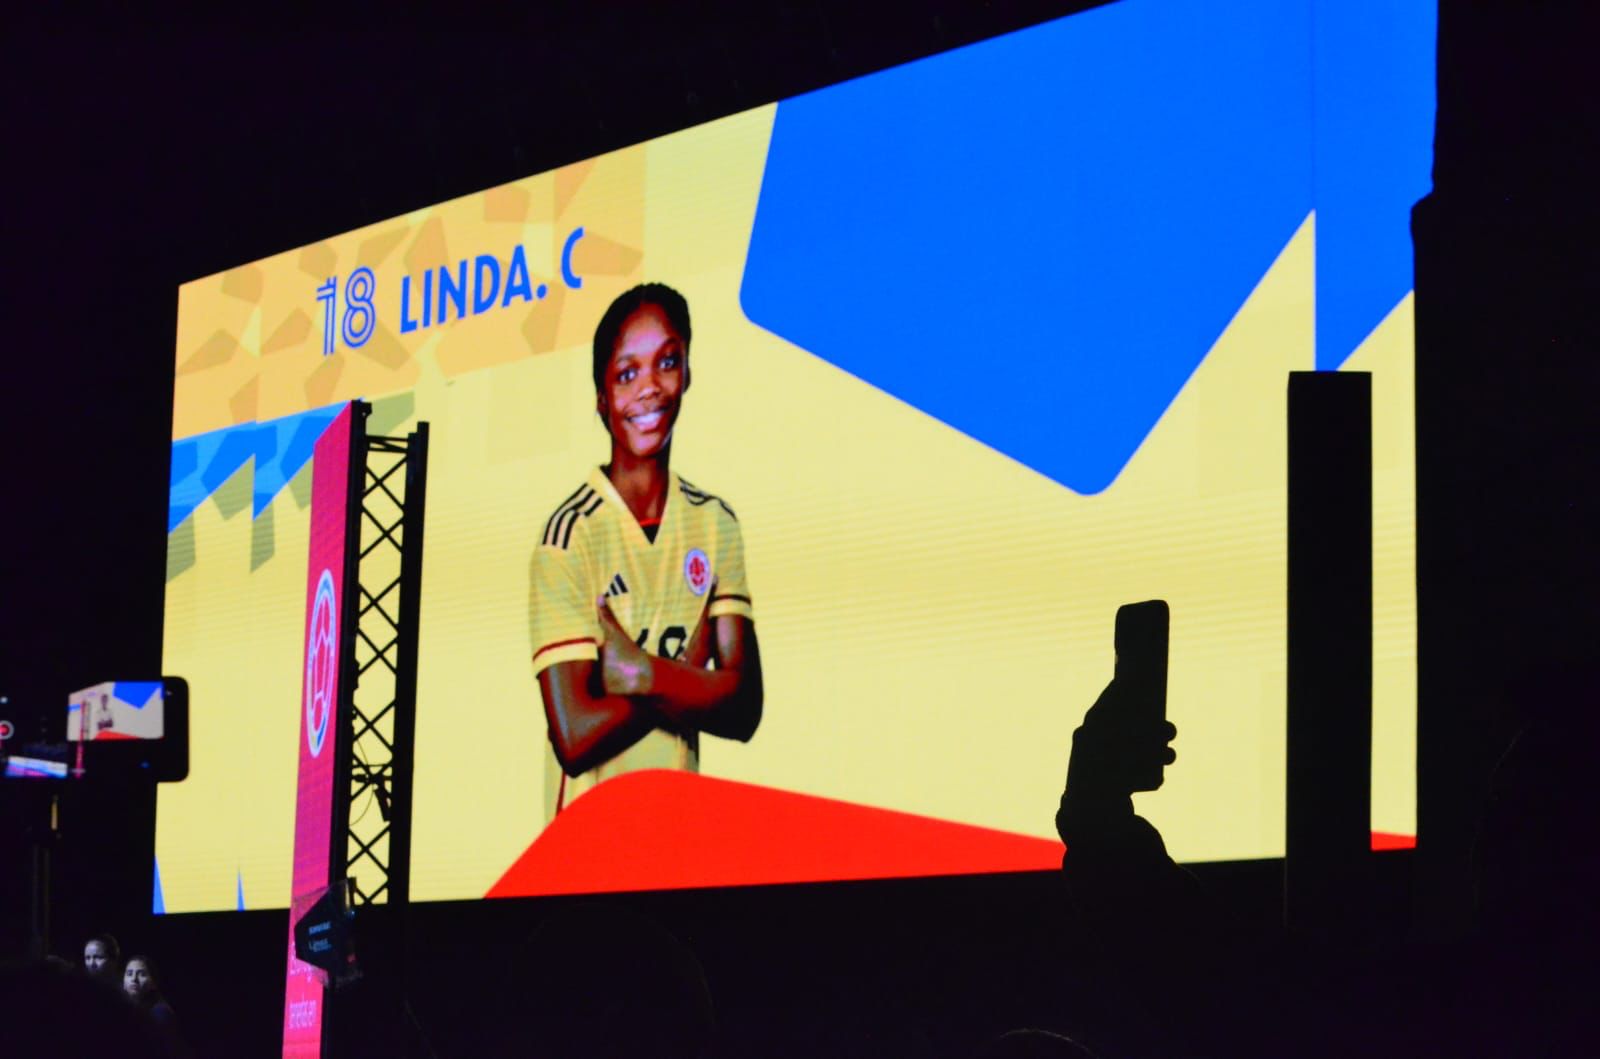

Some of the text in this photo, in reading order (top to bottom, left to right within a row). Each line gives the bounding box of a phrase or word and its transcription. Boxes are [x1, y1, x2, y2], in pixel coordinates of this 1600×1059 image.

[316, 226, 584, 356] 18 LINDA. C
